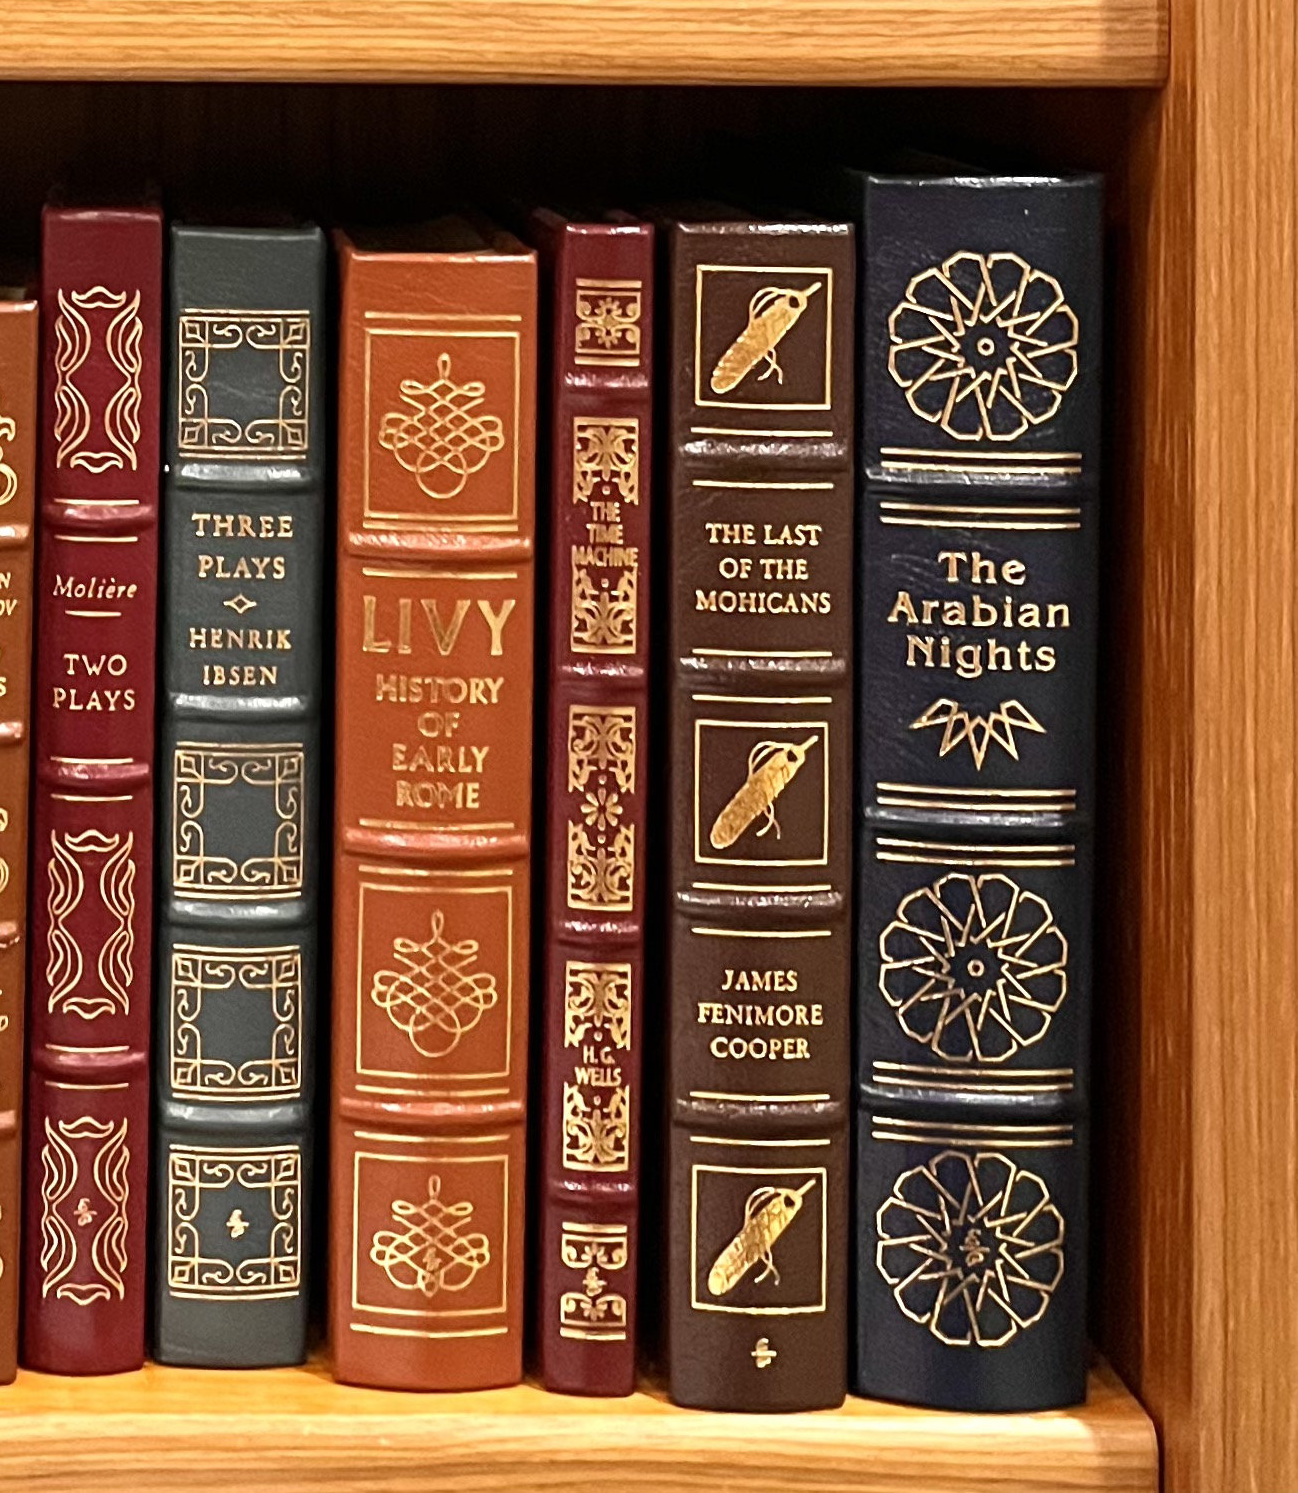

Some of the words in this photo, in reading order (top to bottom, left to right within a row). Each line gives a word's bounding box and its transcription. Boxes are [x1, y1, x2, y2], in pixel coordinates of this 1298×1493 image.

[589, 500, 621, 523] THE
[190, 511, 295, 539] THREE
[585, 522, 624, 546] TIME
[704, 522, 757, 546] THE
[763, 524, 823, 547] LAST
[197, 554, 287, 580] PLAYS
[571, 544, 639, 568] MACHINE
[937, 550, 1028, 587] The
[717, 557, 753, 580] OF
[759, 558, 810, 582] THE
[51, 574, 138, 600] Molière
[694, 588, 833, 616] MOHICANS
[886, 590, 1072, 629] Arabian
[188, 626, 293, 651] HENRIK
[362, 594, 517, 657] LIVY
[62, 653, 128, 677] TWO
[905, 634, 1058, 680] Nights
[201, 664, 279, 687] IBSEN
[374, 672, 505, 705] HISTORY
[51, 686, 137, 712] PLAYS
[417, 710, 462, 739] OF
[391, 742, 490, 774] EARLY
[395, 779, 481, 809] ROME
[720, 968, 799, 993] JAMES
[696, 1001, 825, 1027] FENIMORE
[709, 1035, 812, 1061] COOPER
[573, 1066, 622, 1087] WELLS
